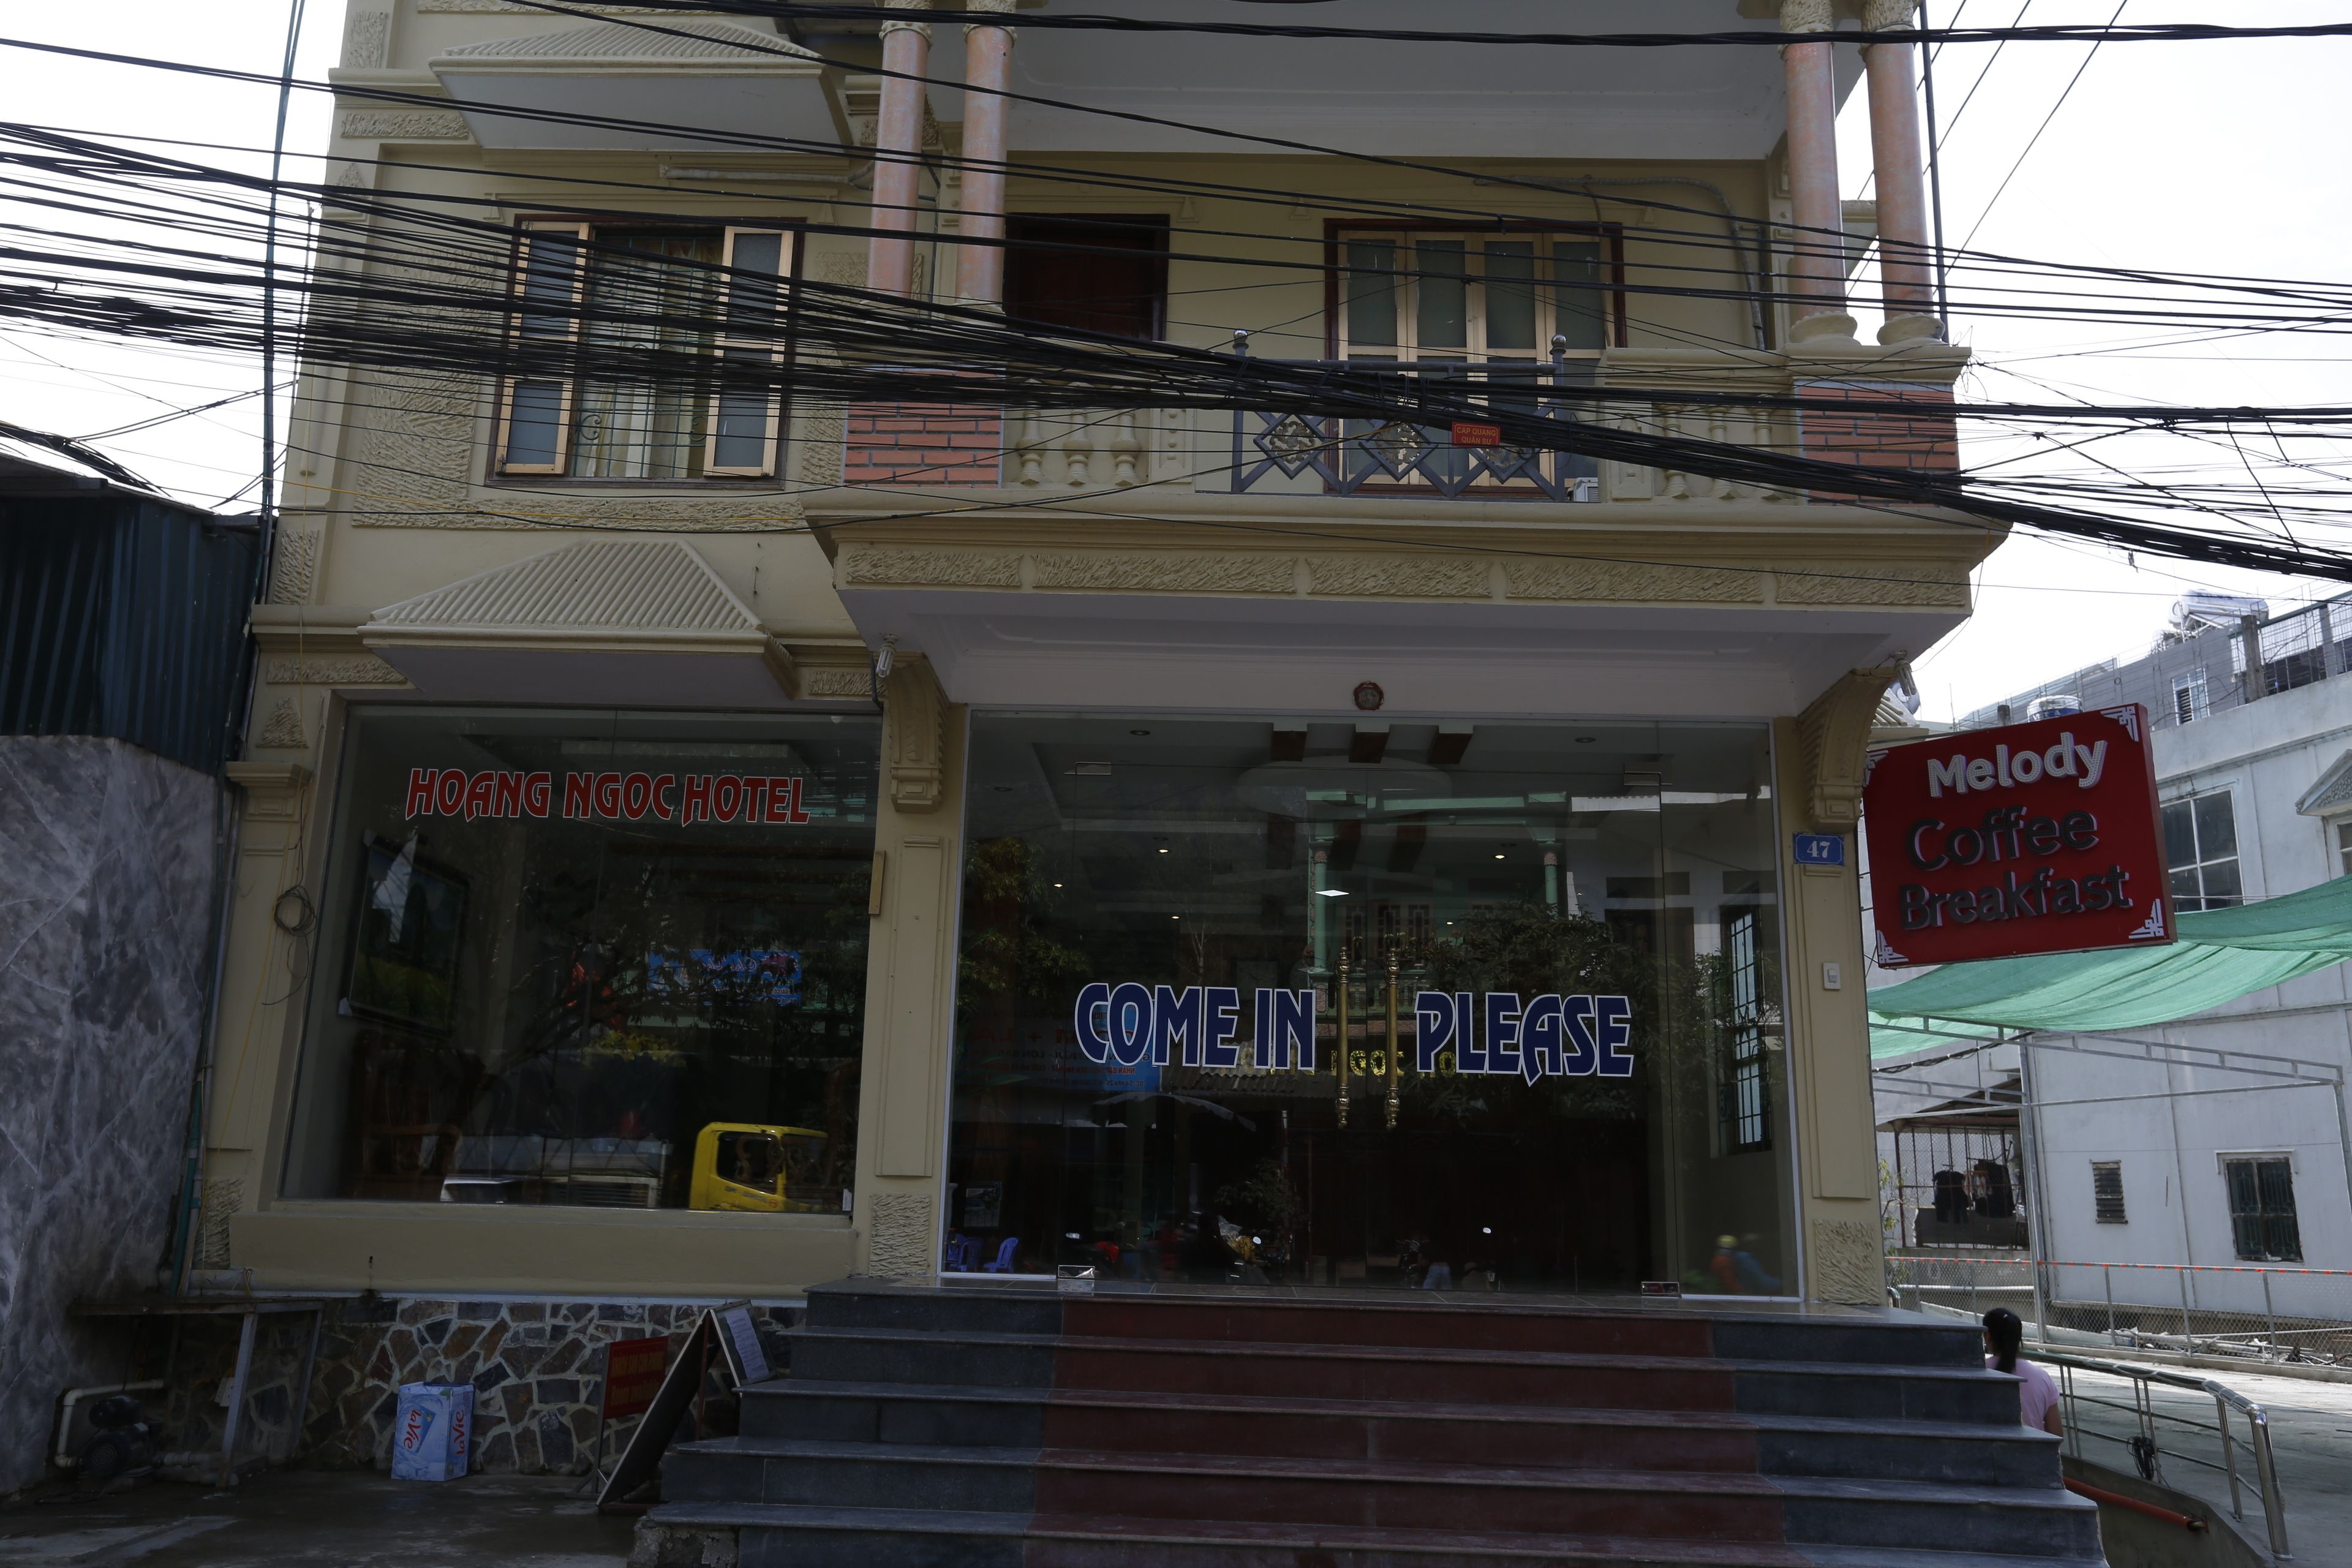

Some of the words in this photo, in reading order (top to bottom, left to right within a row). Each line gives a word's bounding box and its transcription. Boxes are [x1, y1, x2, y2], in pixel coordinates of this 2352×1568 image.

[1472, 428, 1496, 437] QUANG
[1927, 731, 2108, 798] Melody
[405, 767, 551, 823] HOANG
[562, 771, 676, 820] NGOC
[682, 774, 812, 829] HOTEL
[1806, 840, 1831, 859] 47
[1909, 806, 2100, 871] Coffee
[1900, 864, 2133, 929] Breakfast
[1074, 982, 1241, 1068] COME
[1254, 987, 1316, 1071] IN
[1413, 990, 1635, 1087] PLEASE
